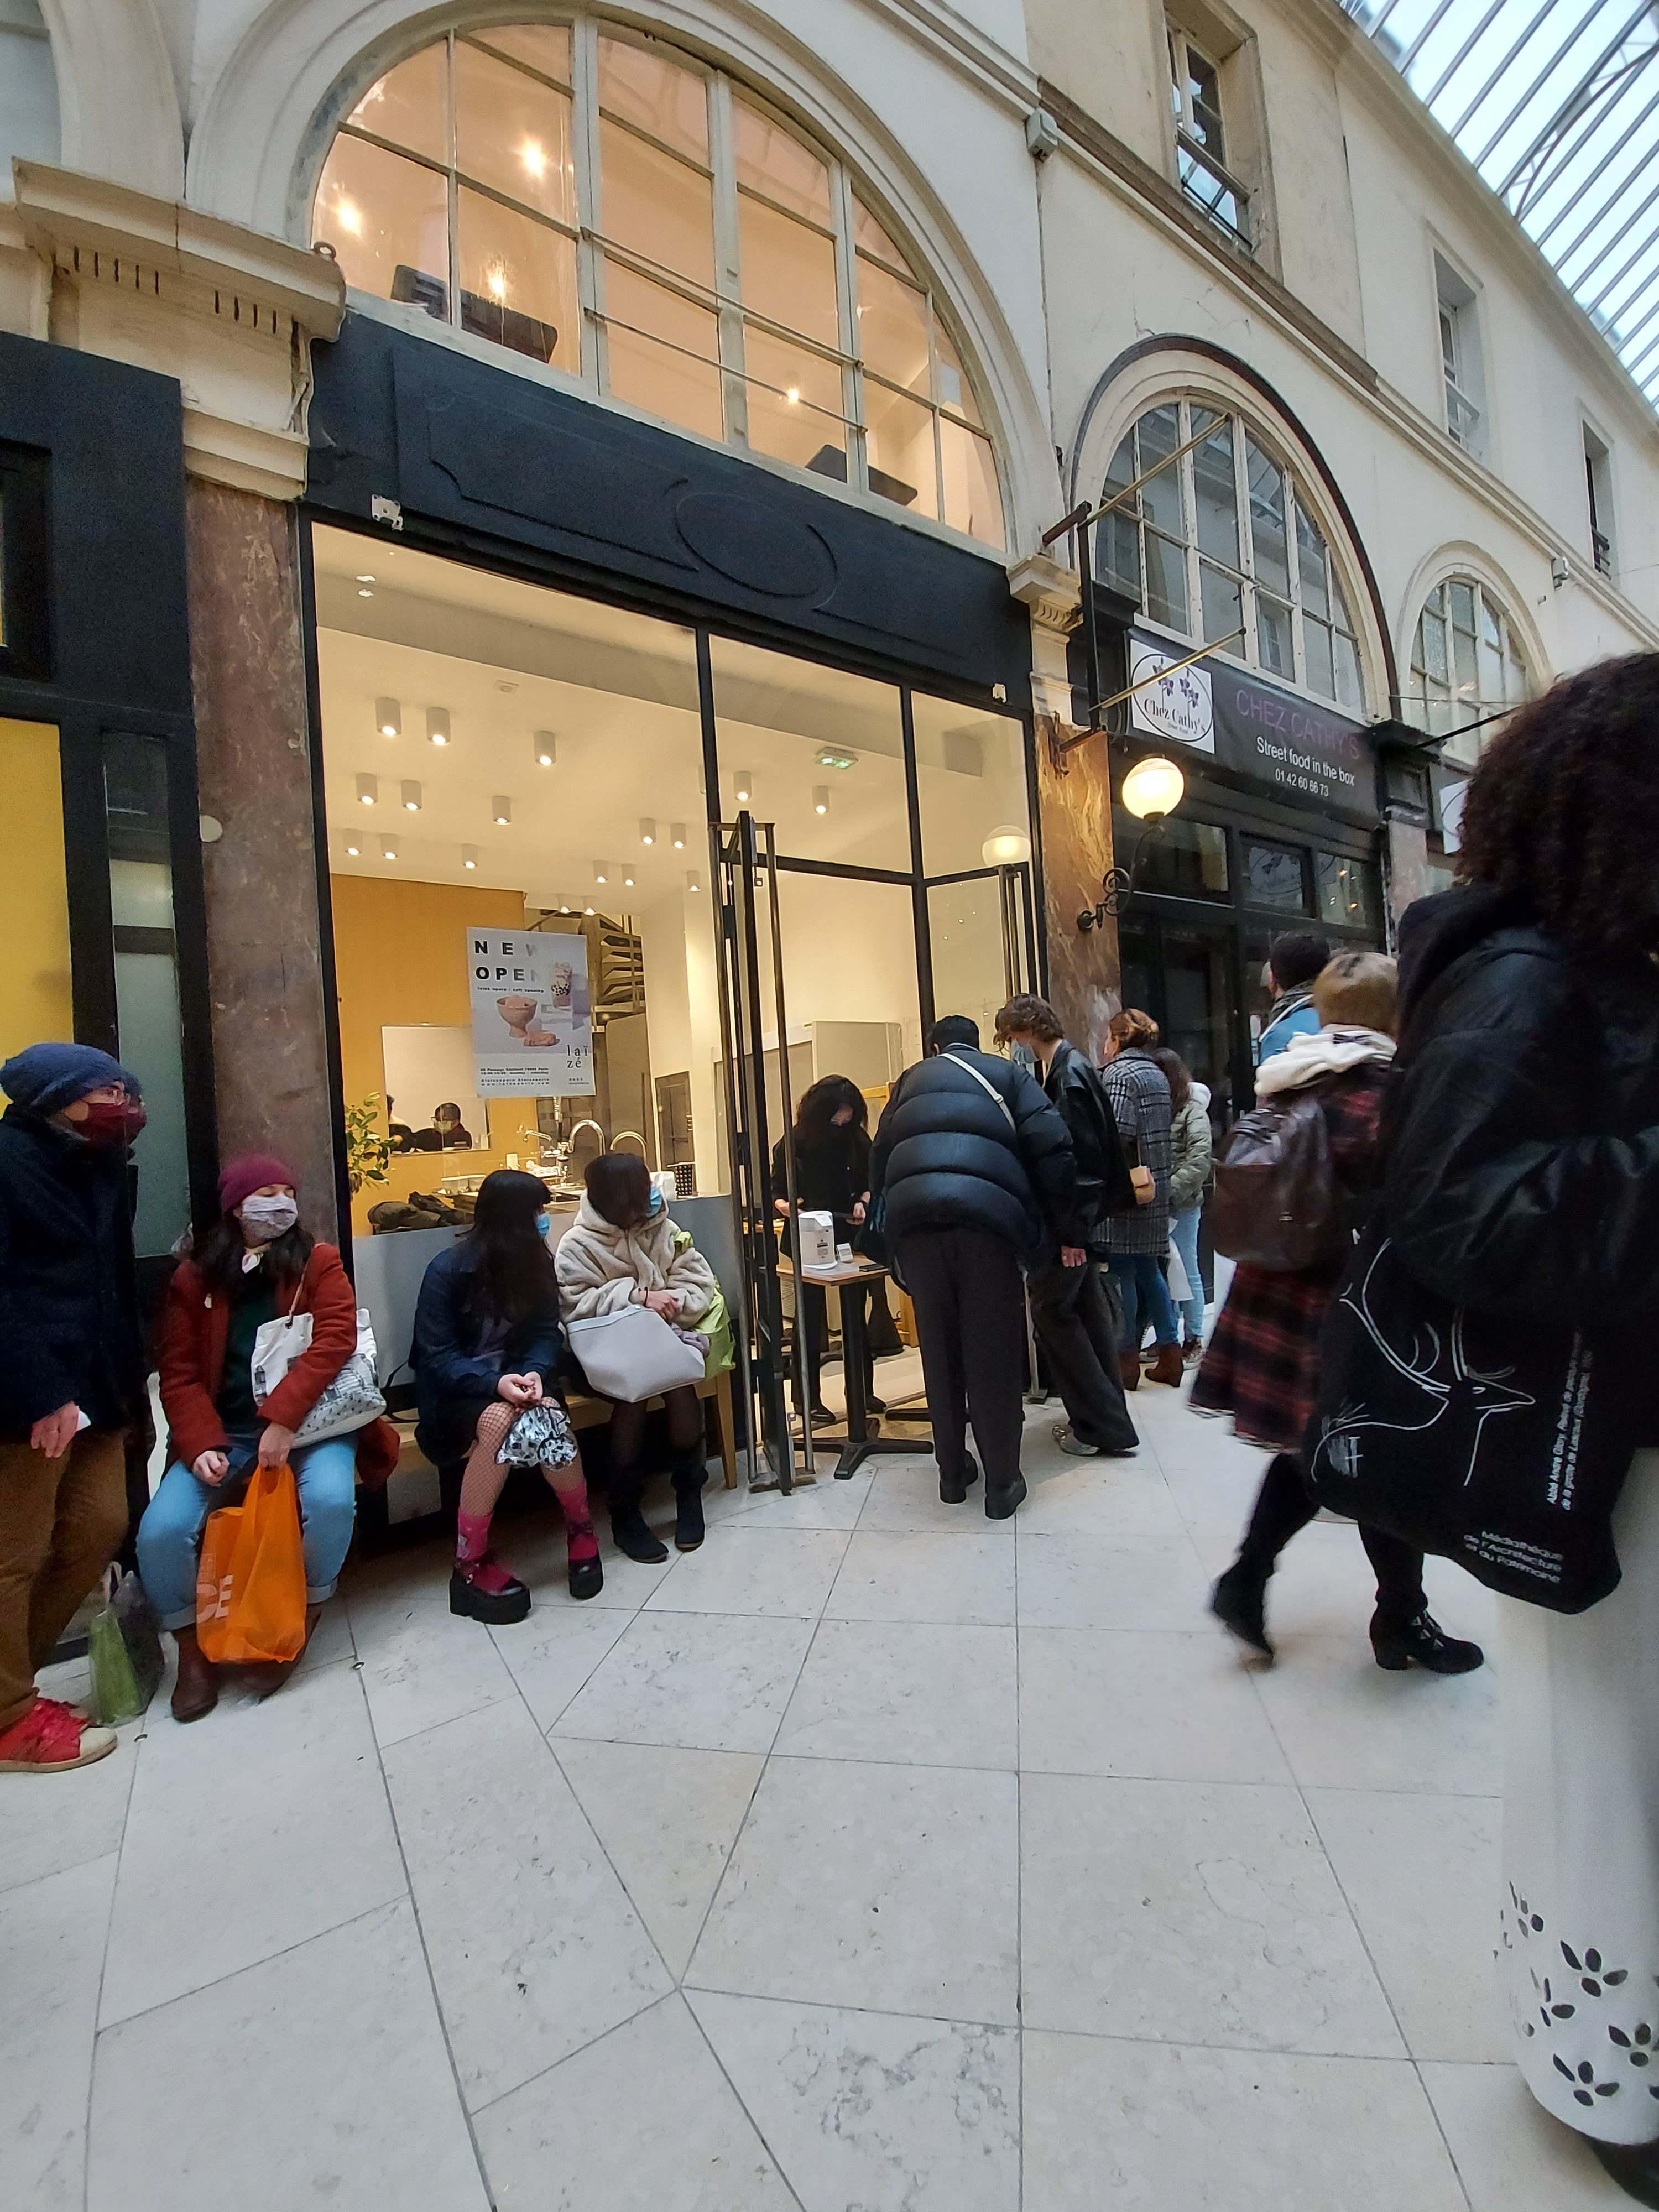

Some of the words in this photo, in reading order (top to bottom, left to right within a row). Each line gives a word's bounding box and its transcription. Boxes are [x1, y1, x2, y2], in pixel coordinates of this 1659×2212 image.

[1144, 698, 1170, 719] Chez
[1172, 709, 1206, 734] Cathy's
[1237, 690, 1286, 732] CHEZ
[1256, 736, 1287, 762] Street
[1289, 748, 1310, 770] food
[1312, 757, 1321, 774] in
[1323, 761, 1337, 779] the
[1339, 766, 1355, 786] box
[1275, 768, 1285, 782] 01
[1286, 774, 1297, 786] 42
[1298, 776, 1308, 790] 60
[1320, 784, 1329, 797] 73
[567, 1044, 588, 1056] laï
[567, 1057, 582, 1068] zé
